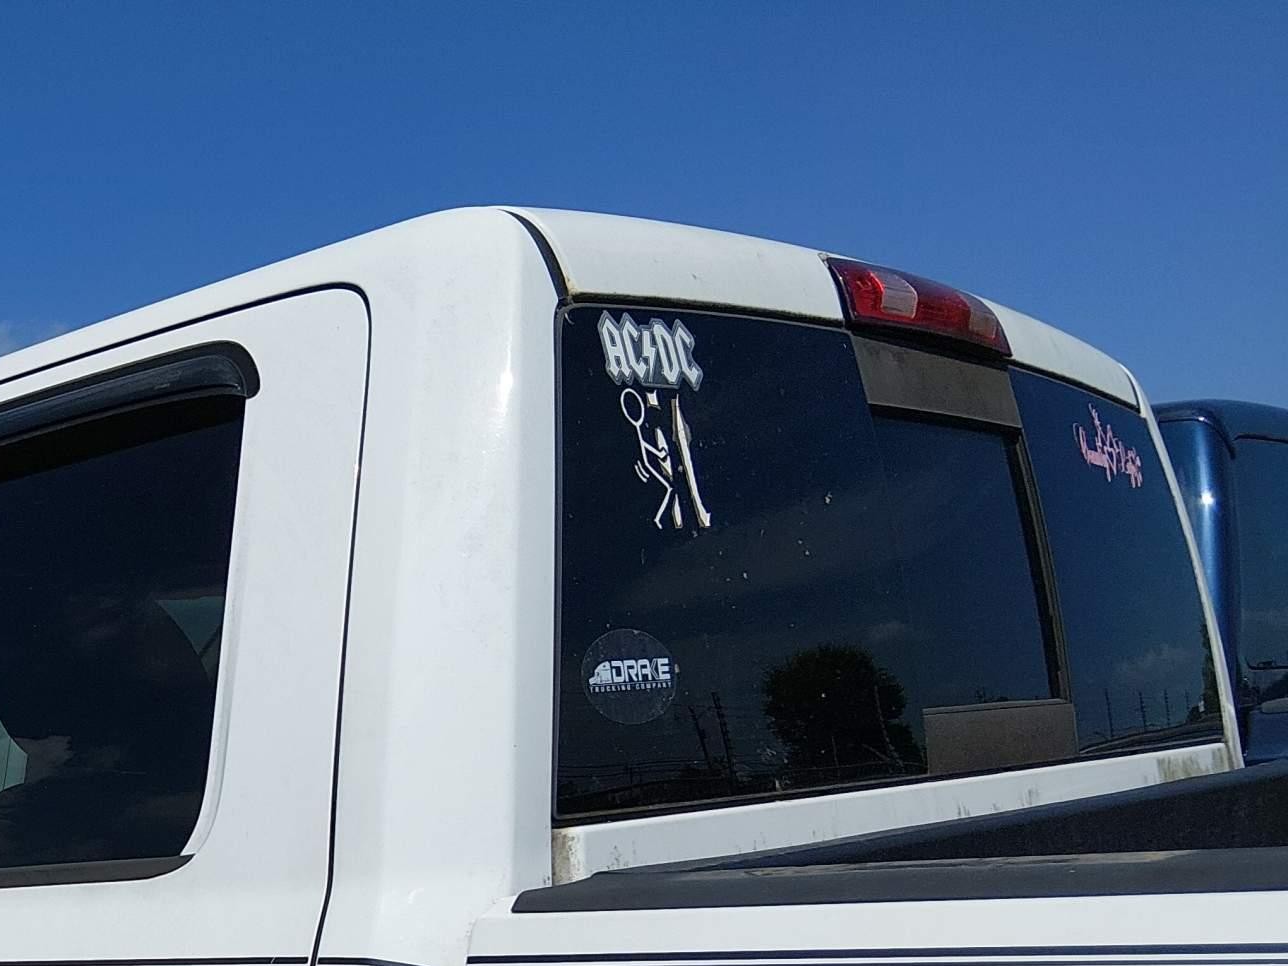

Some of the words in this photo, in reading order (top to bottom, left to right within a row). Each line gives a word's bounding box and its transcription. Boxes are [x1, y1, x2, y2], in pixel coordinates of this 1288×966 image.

[611, 658, 671, 682] DRAKE
[590, 684, 631, 693] TRUCKING
[635, 682, 672, 690] COMPANY
